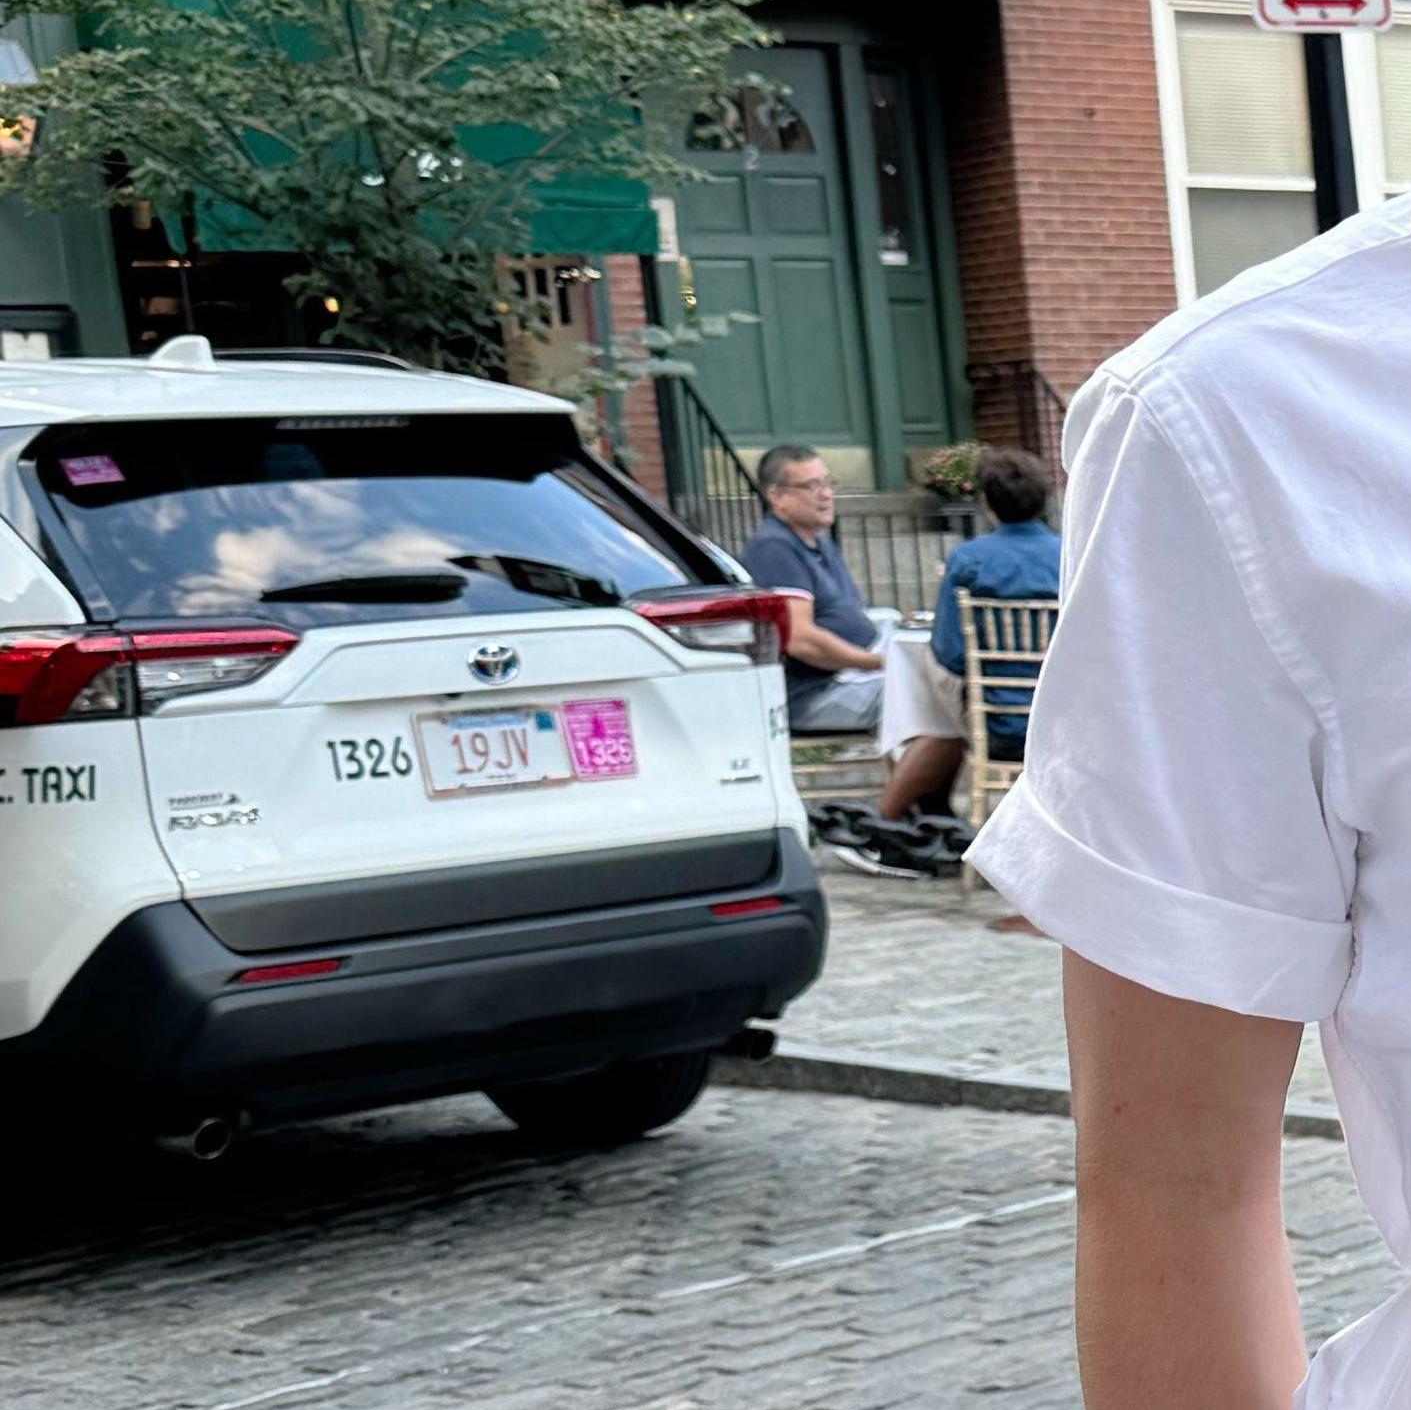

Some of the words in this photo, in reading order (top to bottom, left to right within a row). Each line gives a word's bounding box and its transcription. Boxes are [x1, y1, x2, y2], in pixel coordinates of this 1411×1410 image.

[326, 736, 413, 782] 1326
[451, 728, 529, 774] 19JV
[576, 737, 634, 767] 1326
[21, 764, 96, 804] TAXI
